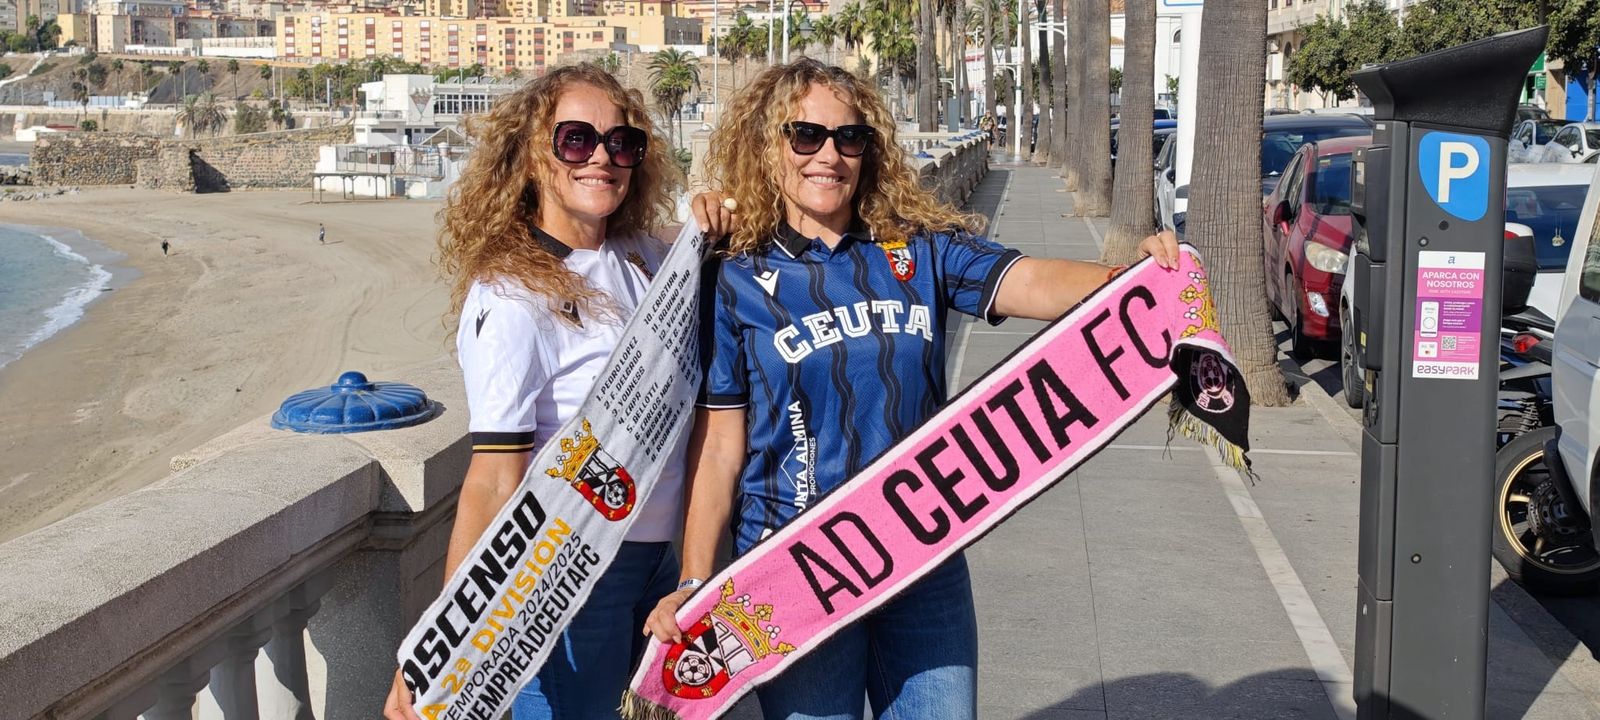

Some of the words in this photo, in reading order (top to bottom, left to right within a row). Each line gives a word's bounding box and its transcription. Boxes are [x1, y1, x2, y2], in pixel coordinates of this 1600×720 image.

[1438, 142, 1480, 203] P
[652, 270, 678, 313] CRISTIAN
[1422, 271, 1458, 280] APARCA
[1459, 272, 1480, 281] CON
[1426, 280, 1475, 289] NOSOTROS
[658, 290, 680, 323] AQUINO
[667, 296, 686, 329] VICTOR
[774, 299, 934, 364] CEUTA
[601, 364, 622, 395] PEDRO
[619, 336, 639, 366] LOPEZ
[616, 350, 643, 392] DELGADO
[618, 365, 646, 407] YOUNESS
[625, 391, 642, 419] CAPA
[632, 382, 659, 426] BELLOTTI
[640, 397, 661, 433] CARLOS
[787, 400, 808, 464] ALMINA
[788, 511, 895, 616] AD
[881, 358, 1100, 546] CEUTA
[1080, 285, 1172, 402] FC
[808, 436, 817, 495] PROMOCIONES
[793, 469, 809, 512] UNTA
[402, 490, 547, 704] ASCENSO
[518, 532, 583, 626] 2024/2025
[461, 543, 600, 720] IEMPREADCEUTAFC
